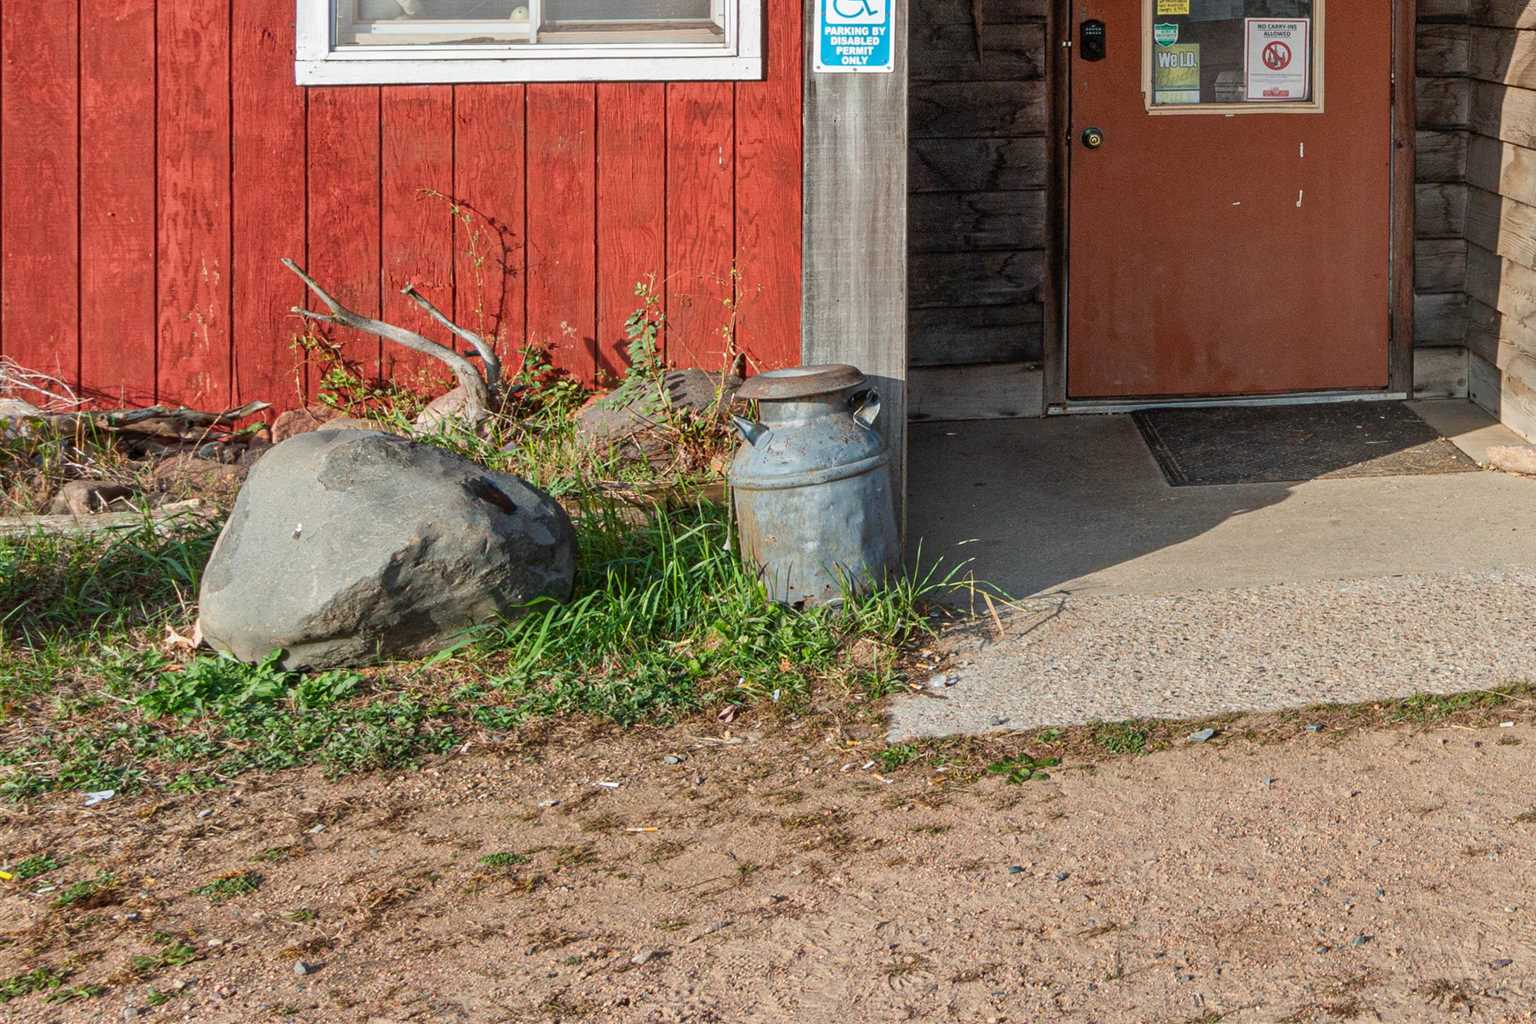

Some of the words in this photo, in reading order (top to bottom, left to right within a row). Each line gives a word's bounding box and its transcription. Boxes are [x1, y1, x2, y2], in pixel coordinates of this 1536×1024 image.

[825, 27, 869, 36] PARKING
[872, 27, 886, 36] BY
[830, 37, 880, 46] DISABLED
[836, 46, 874, 56] PERMIT
[841, 55, 869, 65] ONLY
[1158, 52, 1177, 67] We
